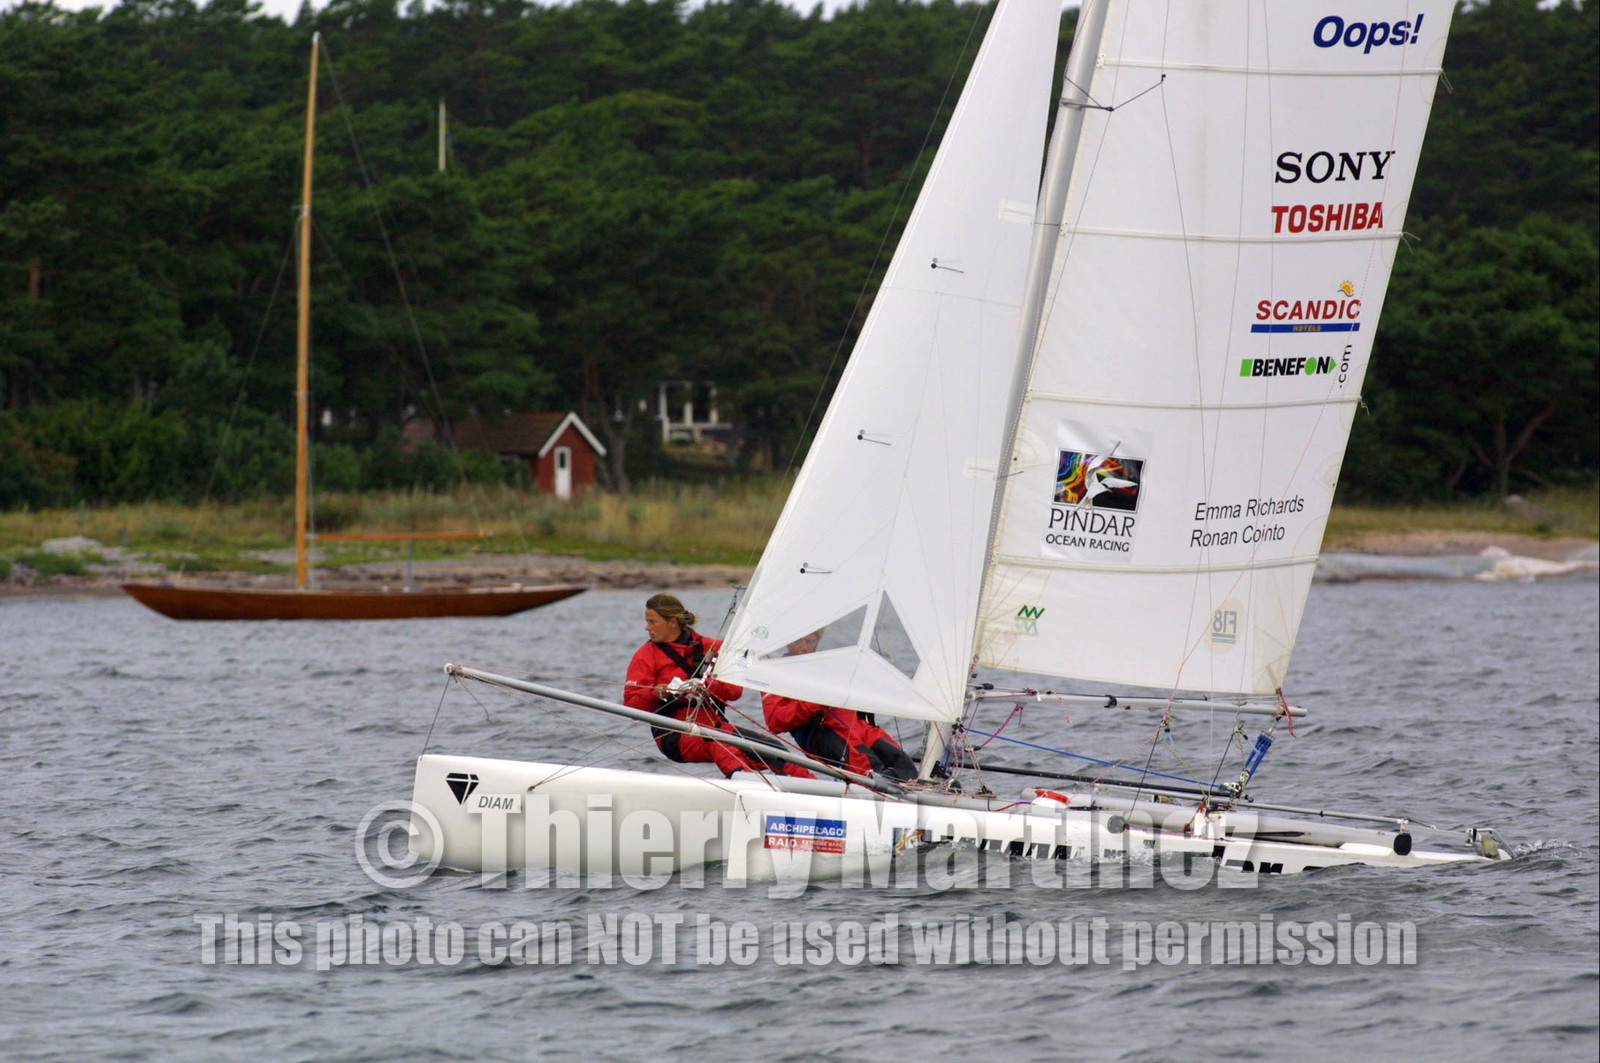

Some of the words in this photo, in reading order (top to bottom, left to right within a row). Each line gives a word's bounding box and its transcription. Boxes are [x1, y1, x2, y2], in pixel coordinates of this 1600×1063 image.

[1313, 13, 1424, 54] Oops!
[1275, 151, 1395, 183] SONY
[1271, 202, 1384, 234] TOSHIBA
[1256, 300, 1361, 320] SCANDIC
[1251, 356, 1331, 377] BENEFON
[1338, 345, 1352, 388] .com
[1195, 502, 1241, 521] Emma
[1246, 495, 1305, 517] Richards
[1048, 508, 1135, 537] PINDAR
[1046, 533, 1086, 547] OCEAN
[1089, 538, 1130, 552] RACING
[1190, 529, 1238, 547] Ronan
[1242, 524, 1286, 543] Cointo
[478, 796, 514, 810] DIAM
[770, 823, 844, 836] ARCHIPELAGO
[768, 837, 798, 848] RAID
